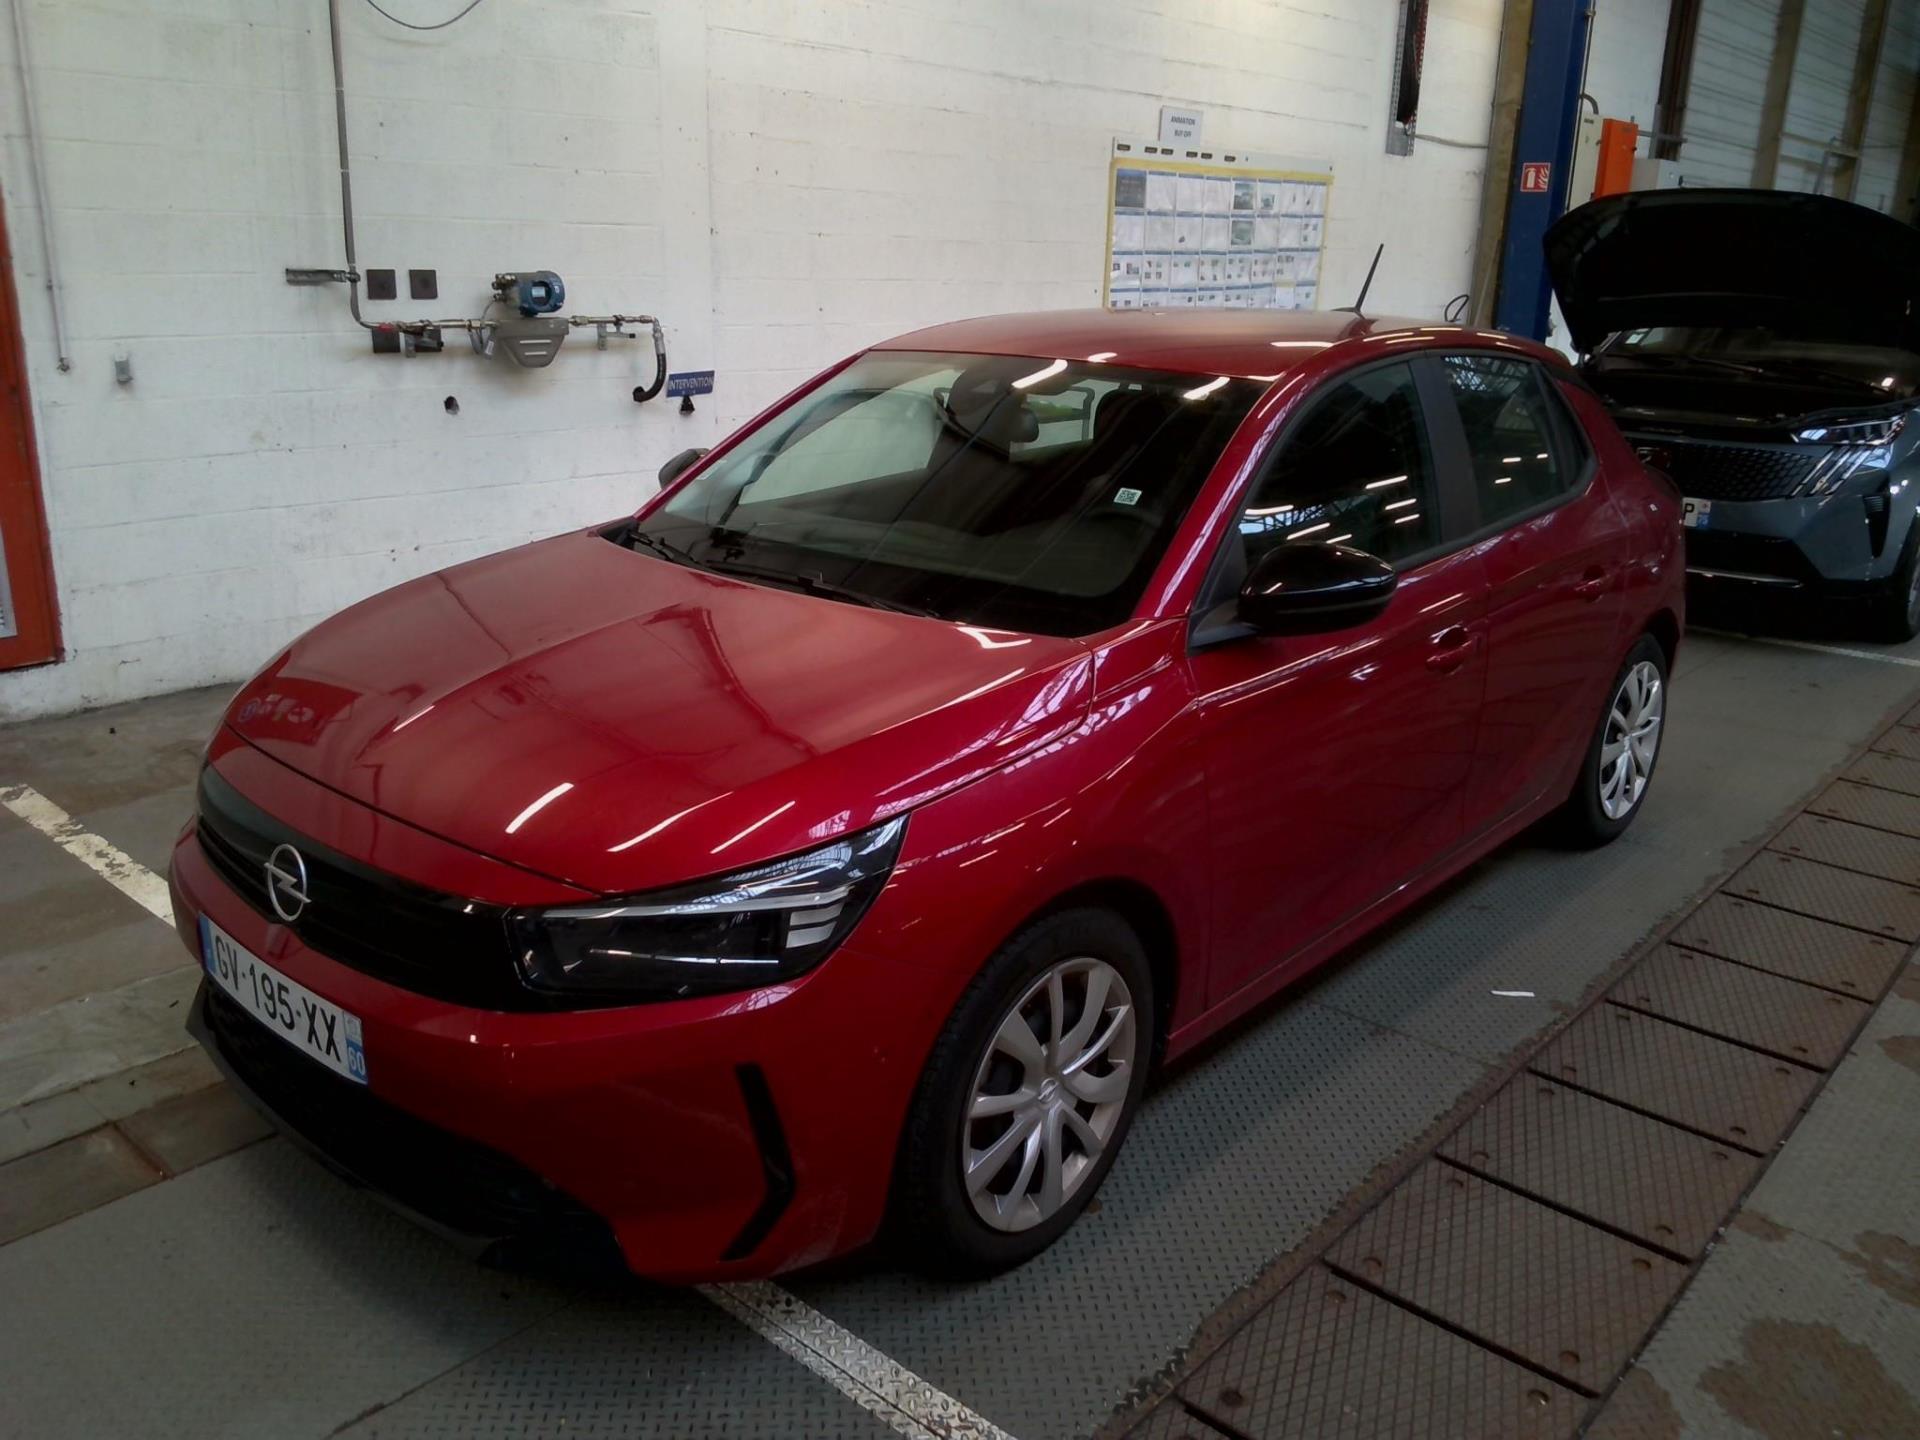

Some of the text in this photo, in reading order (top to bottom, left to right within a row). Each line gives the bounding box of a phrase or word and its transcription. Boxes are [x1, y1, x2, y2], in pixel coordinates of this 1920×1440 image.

[668, 376, 714, 391] INTERVENTION
[214, 934, 343, 1063] GV-195-XX
[347, 1046, 366, 1076] 60
